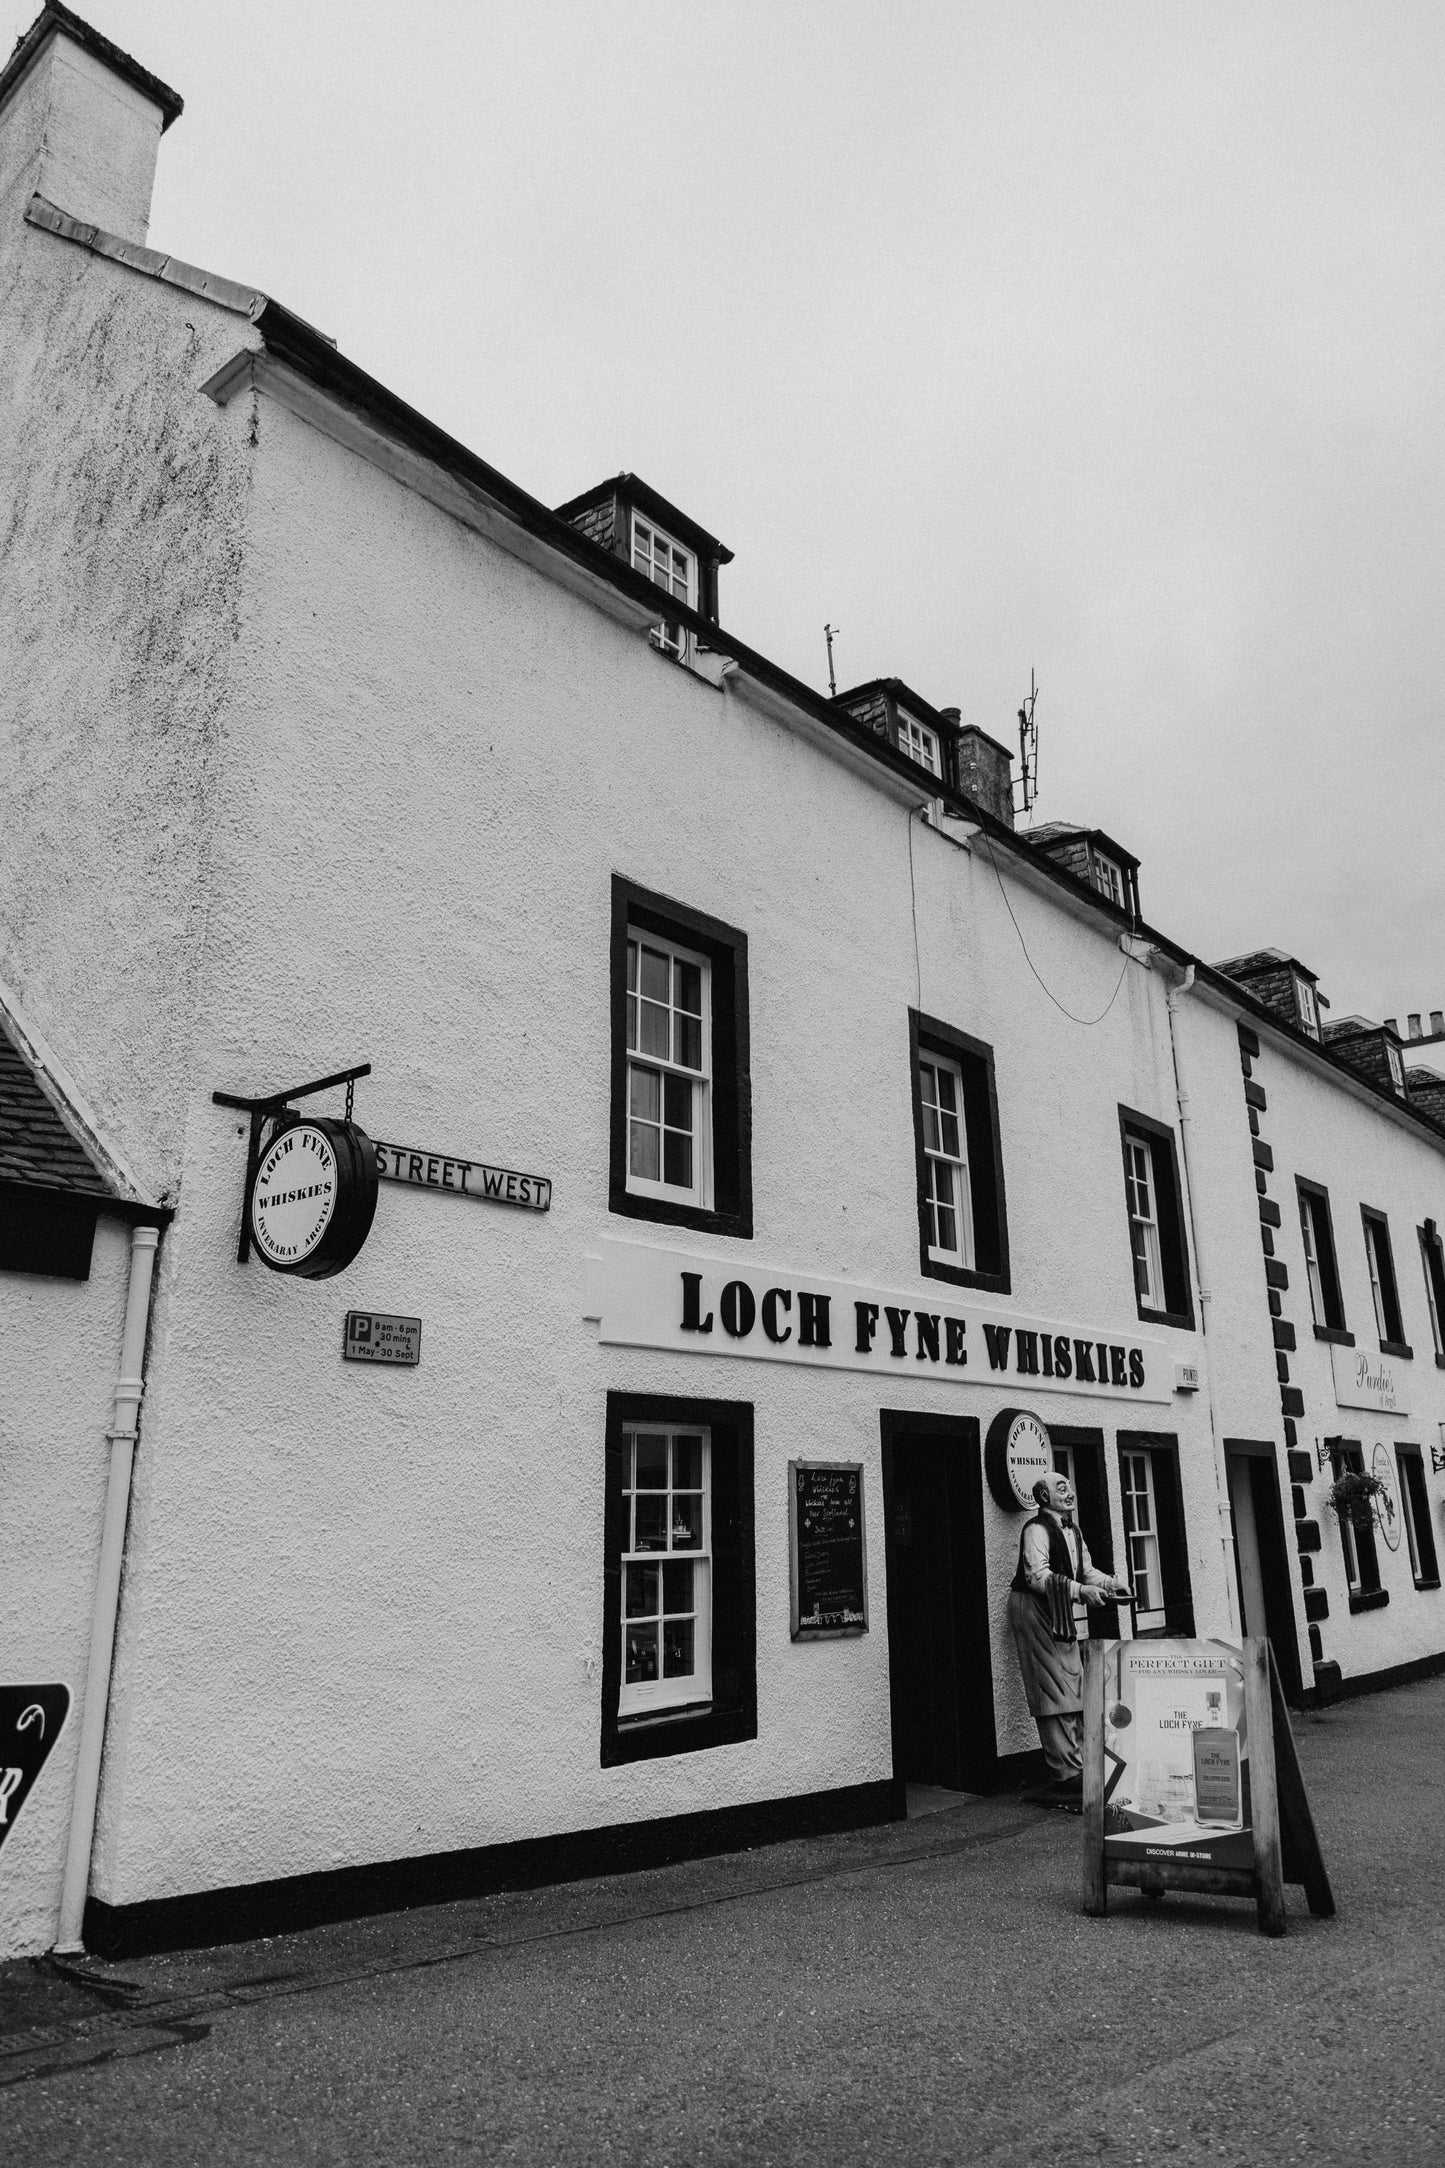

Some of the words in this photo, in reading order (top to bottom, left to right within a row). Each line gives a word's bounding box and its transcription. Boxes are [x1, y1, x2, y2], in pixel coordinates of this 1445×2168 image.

[260, 1136, 294, 1186] LOCH
[301, 1133, 332, 1171] FYNE
[375, 1146, 472, 1192] STREET
[482, 1169, 546, 1205] WEST
[258, 1181, 332, 1209] WHISKIES
[258, 1216, 298, 1256] INVERARAY
[305, 1198, 331, 1247] ARGYLL
[355, 1318, 369, 1339] P
[375, 1321, 380, 1330] 8
[399, 1324, 404, 1333] 6
[680, 1271, 832, 1347] LOCH
[854, 1301, 968, 1365] FYNE
[982, 1323, 1145, 1388] WHISKIES
[380, 1332, 392, 1341] 30
[392, 1334, 411, 1343] mins
[352, 1345, 356, 1354] 1
[358, 1346, 376, 1357] May
[380, 1348, 393, 1357] 30
[395, 1349, 414, 1360] Sept
[1354, 1352, 1394, 1393] Purdie's
[1010, 1421, 1026, 1449] LOCH
[1029, 1422, 1046, 1451] FYNE
[1009, 1456, 1048, 1466] WHISKIES
[1130, 1660, 1189, 1668] PERFECT
[1193, 1660, 1226, 1668] GIFT
[1159, 1720, 1180, 1729] LOCH
[1182, 1720, 1204, 1729] FYNE
[1173, 1711, 1188, 1720] THE
[1146, 1847, 1174, 1857] DISCOVER
